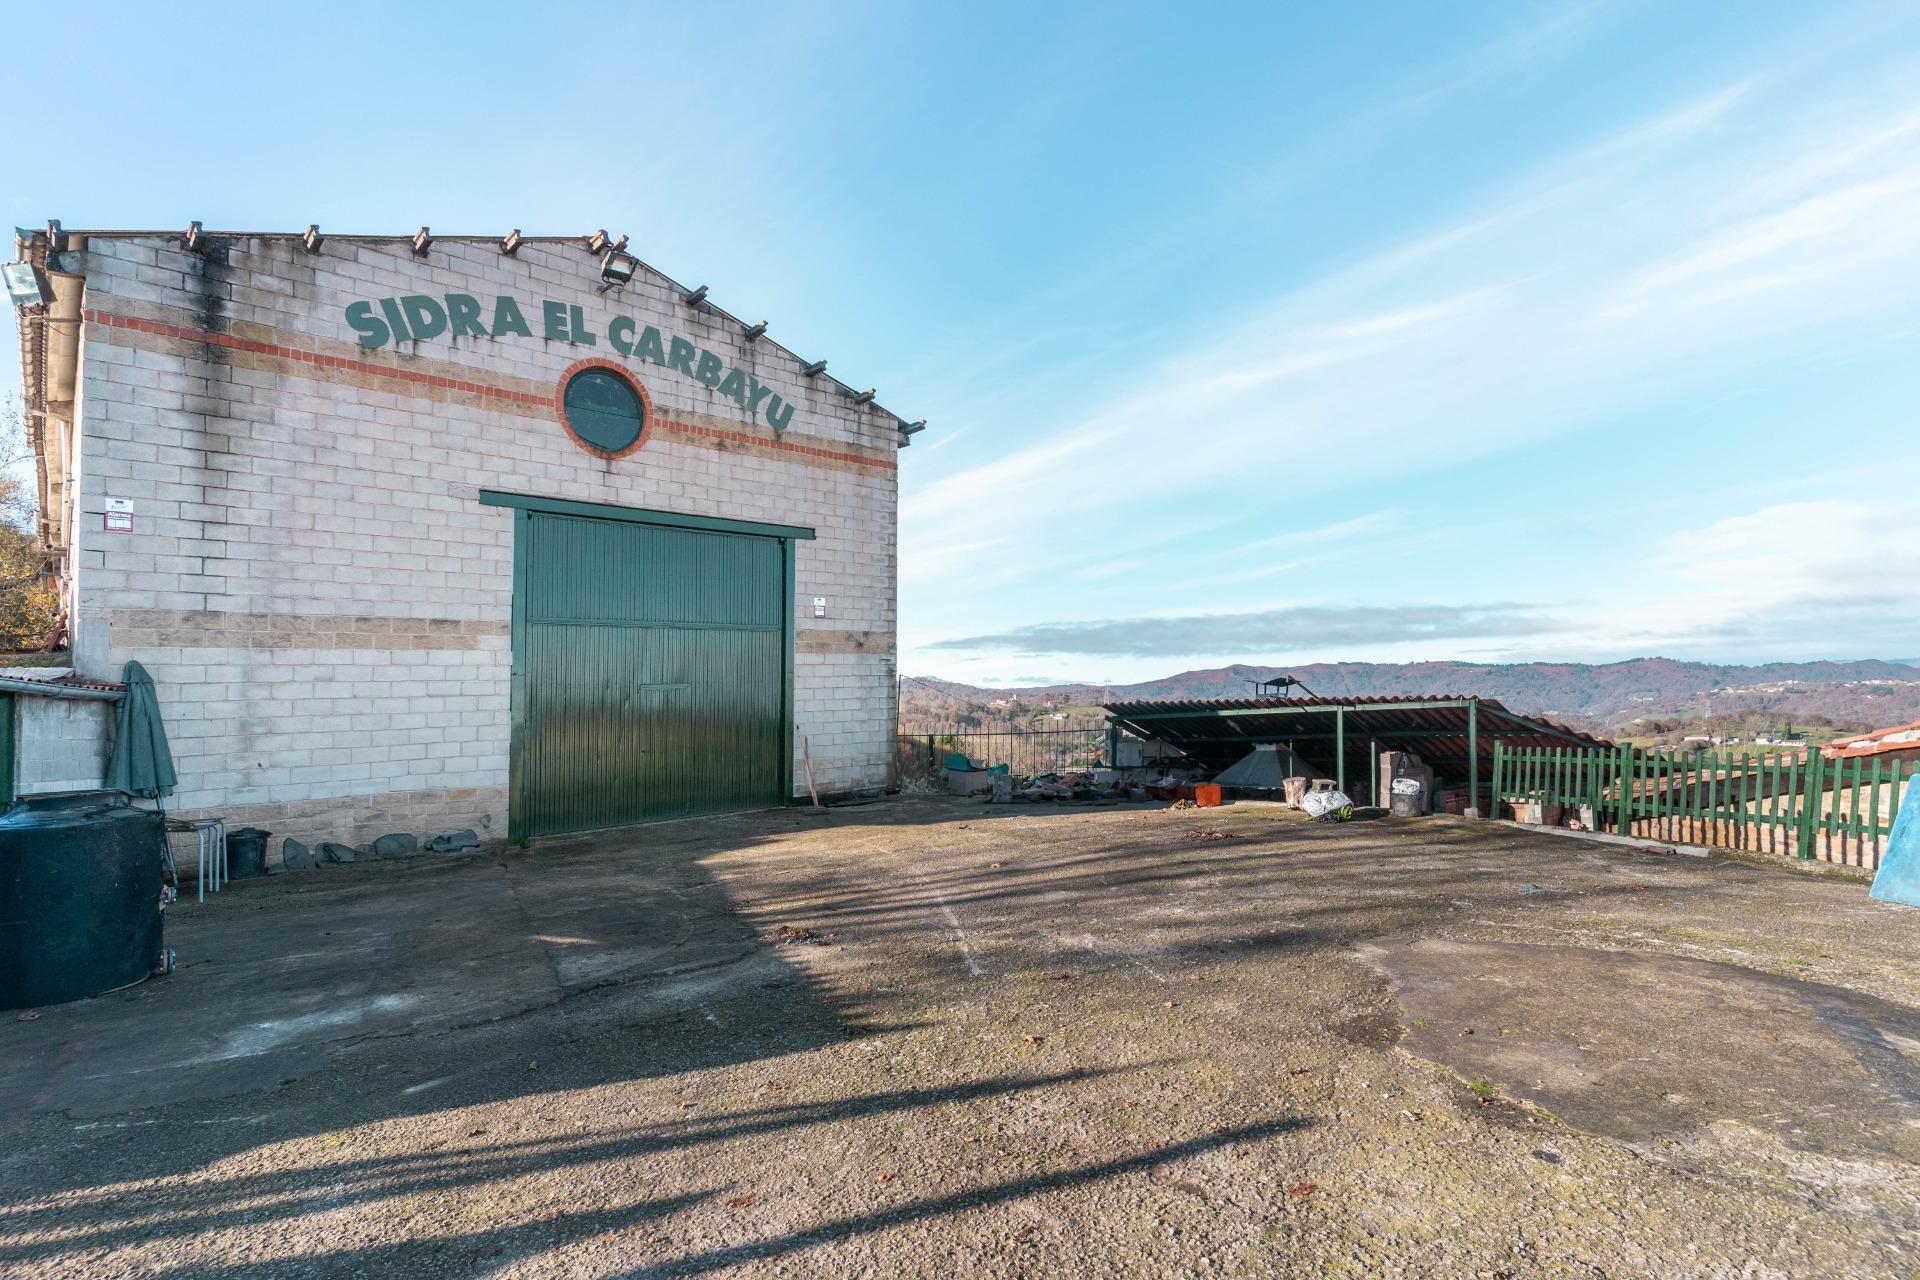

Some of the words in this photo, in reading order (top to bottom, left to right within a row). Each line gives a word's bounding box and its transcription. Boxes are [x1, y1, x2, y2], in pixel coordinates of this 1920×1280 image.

[345, 293, 532, 349] SIDRA
[543, 300, 596, 346] EL
[608, 315, 795, 431] CARBAYU
